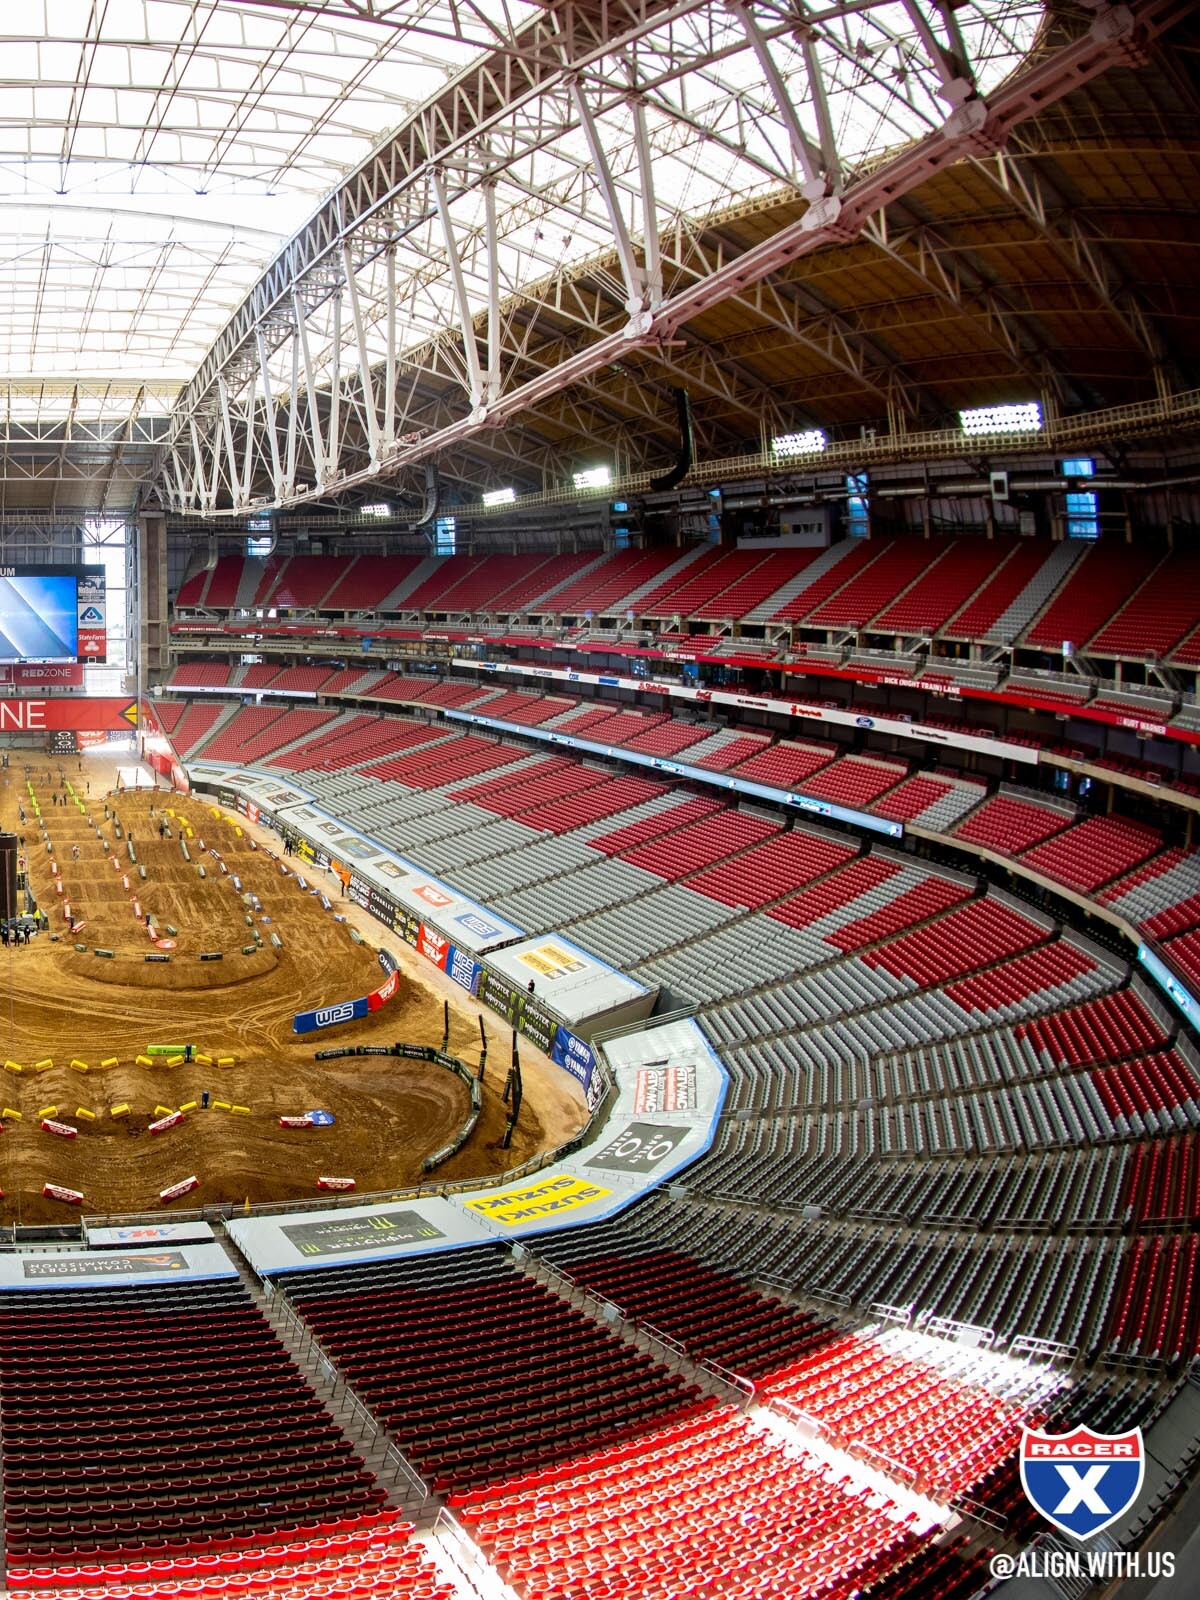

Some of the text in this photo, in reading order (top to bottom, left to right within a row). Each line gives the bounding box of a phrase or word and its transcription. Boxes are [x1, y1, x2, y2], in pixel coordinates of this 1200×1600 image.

[315, 1003, 353, 1027] WPS
[473, 1177, 576, 1211] SUZUKI
[496, 1187, 601, 1222] SUZUKI
[327, 1233, 414, 1250] MONSTER
[29, 1259, 131, 1269] COMMISSION
[30, 1264, 133, 1274] UTAH SPORTS
